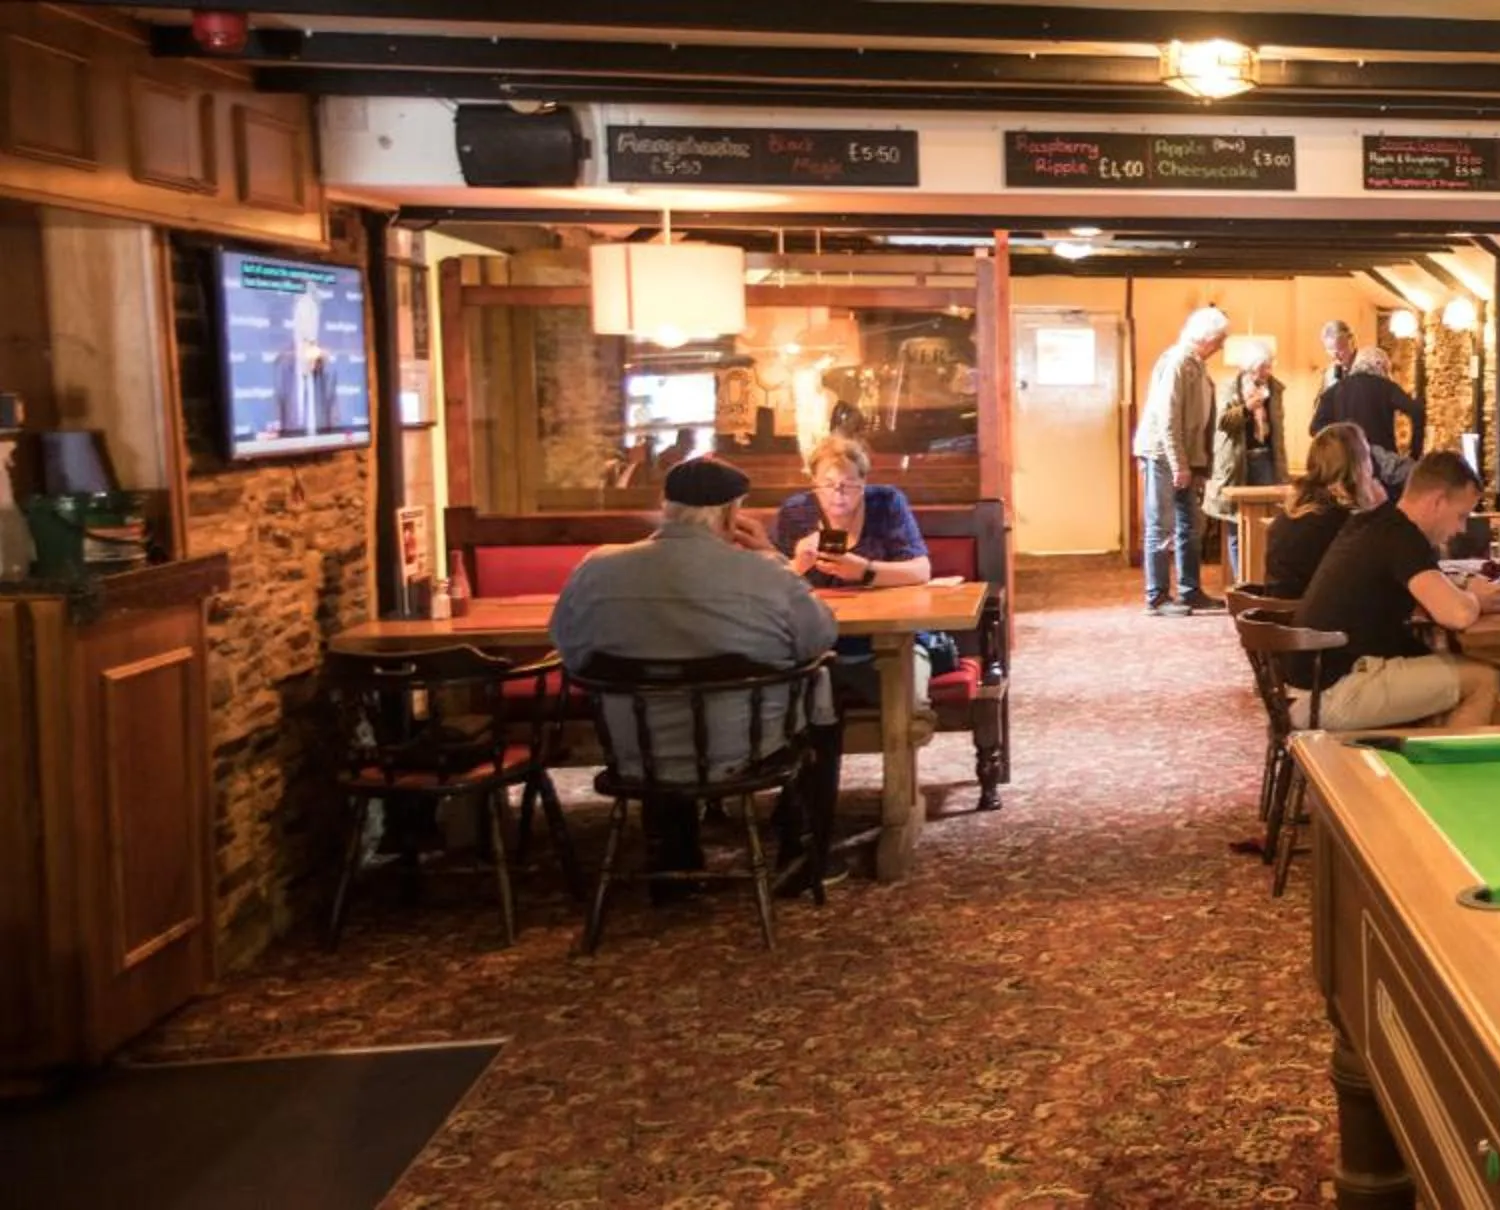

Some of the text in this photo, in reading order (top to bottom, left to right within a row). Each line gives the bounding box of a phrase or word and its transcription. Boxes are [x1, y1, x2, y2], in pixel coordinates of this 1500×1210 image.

[1016, 134, 1099, 160] Raspberry
[1155, 139, 1205, 158] Apple
[1035, 157, 1088, 175] Ripple
[1158, 158, 1259, 179] Cheesecake
